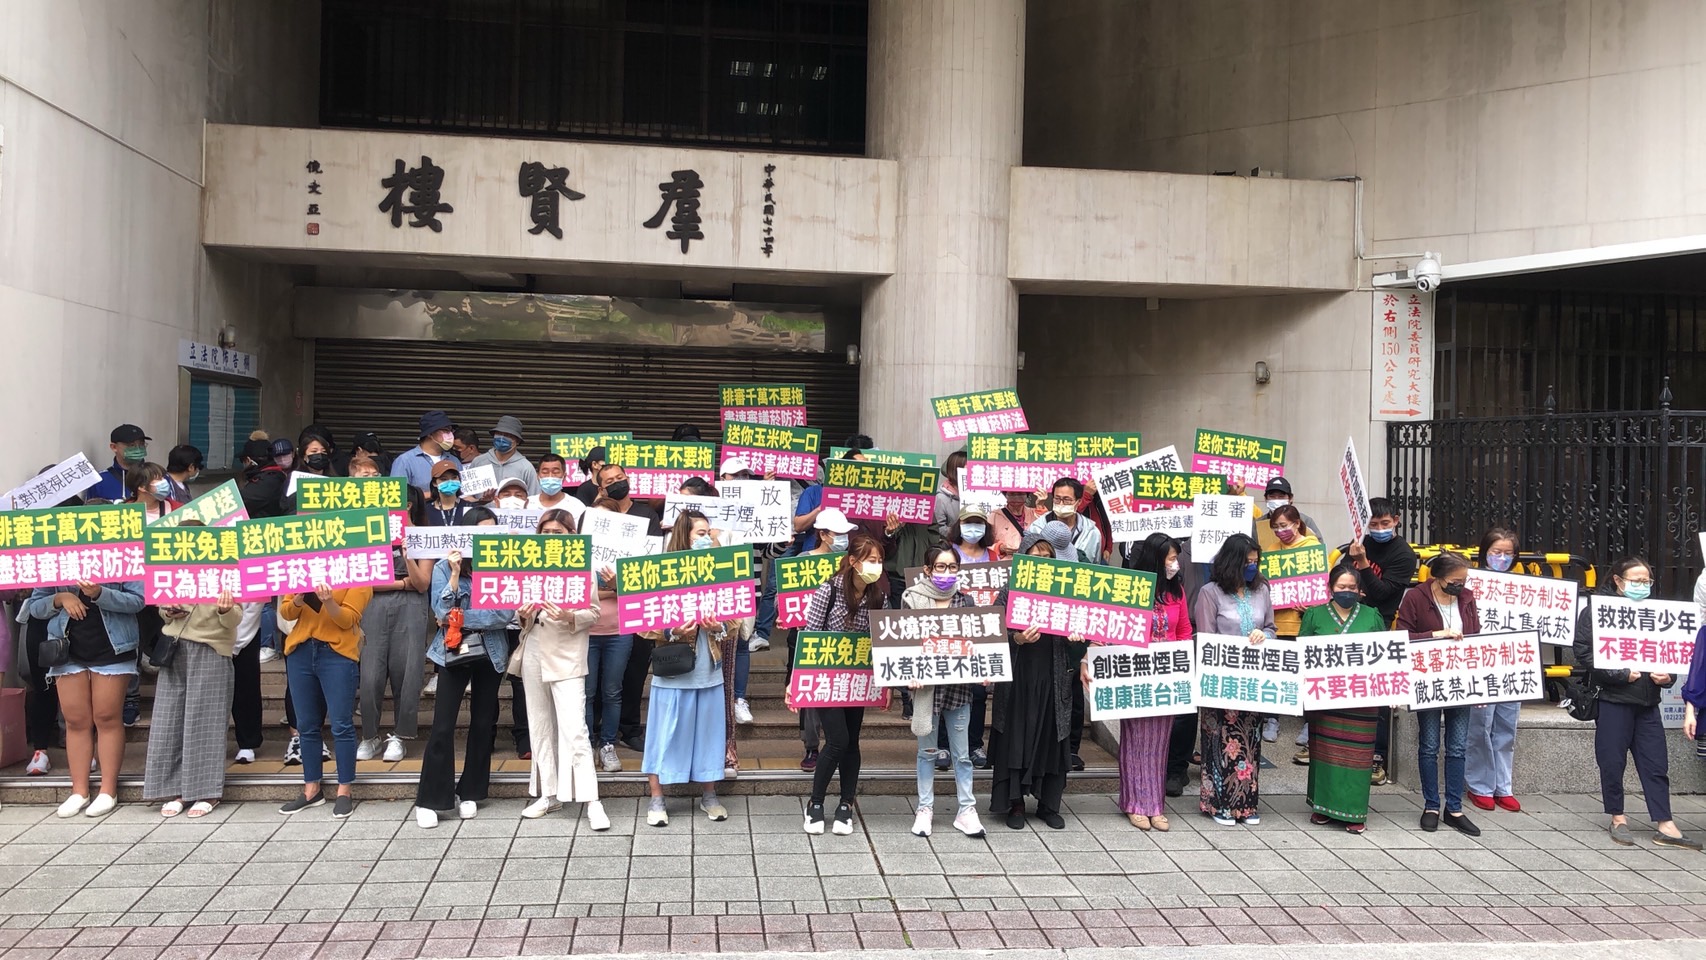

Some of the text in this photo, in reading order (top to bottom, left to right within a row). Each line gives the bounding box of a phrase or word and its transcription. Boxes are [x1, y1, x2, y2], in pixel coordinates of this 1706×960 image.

[1407, 294, 1423, 405] 立法院委員研究大樓
[722, 387, 804, 406] 排審千萬不要拖
[935, 391, 1020, 417] 排審千萬不要拖
[726, 424, 818, 453] 送你玉米咬一口
[971, 436, 1073, 463] 排審千萬不要拖
[1197, 432, 1284, 464] 送你玉米咬一口
[609, 443, 713, 469] 排審千萬不要拖
[828, 461, 936, 493] 送你玉米咬一口
[302, 480, 402, 509] 玉米免費送
[242, 514, 387, 556] 送你玉米咬一口
[478, 539, 586, 569] 玉米免費送
[246, 550, 390, 593] 二手菸害被趕走
[622, 550, 751, 592] 送你玉米咬一口
[1015, 559, 1153, 607] 排審千萬不要拖
[480, 575, 586, 605] 只為護健康
[625, 585, 753, 629] 二手菸害被趕走
[1011, 596, 1147, 643] 盡速審議菸防法
[1597, 603, 1697, 635] 救救青少年
[878, 612, 1002, 640] 火燒菸草能賣
[1092, 649, 1190, 680] 創造無煙島
[1201, 641, 1300, 675] 創造無煙島
[1304, 640, 1408, 670] 救救青少年
[1410, 640, 1535, 674] 速審菸害防制法
[1093, 680, 1192, 711] 健康護台灣
[1199, 672, 1299, 706] 健康護台灣
[1305, 671, 1411, 701] 不要有紙菸
[1413, 669, 1539, 705] 徹底禁止售紙菸
